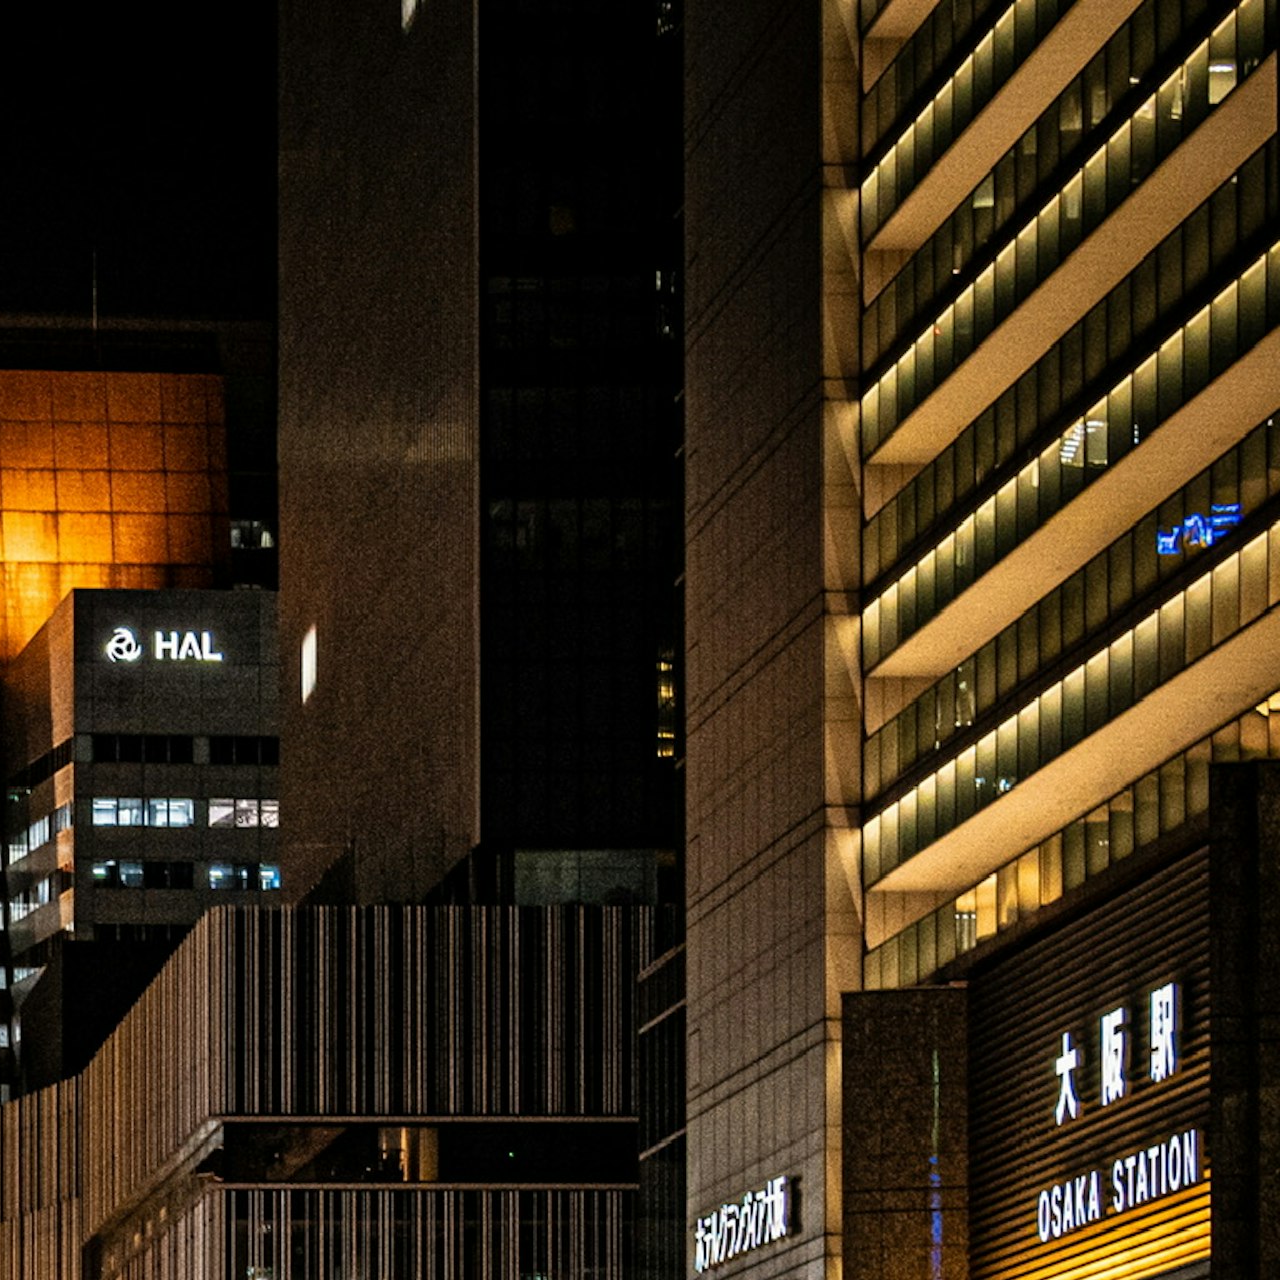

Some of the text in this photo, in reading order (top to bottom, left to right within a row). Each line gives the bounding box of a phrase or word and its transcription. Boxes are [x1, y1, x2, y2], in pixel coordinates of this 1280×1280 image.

[155, 631, 222, 661] HAL
[1055, 982, 1181, 1125] 大阪駅
[1037, 1130, 1199, 1244] OSAKA STATION
